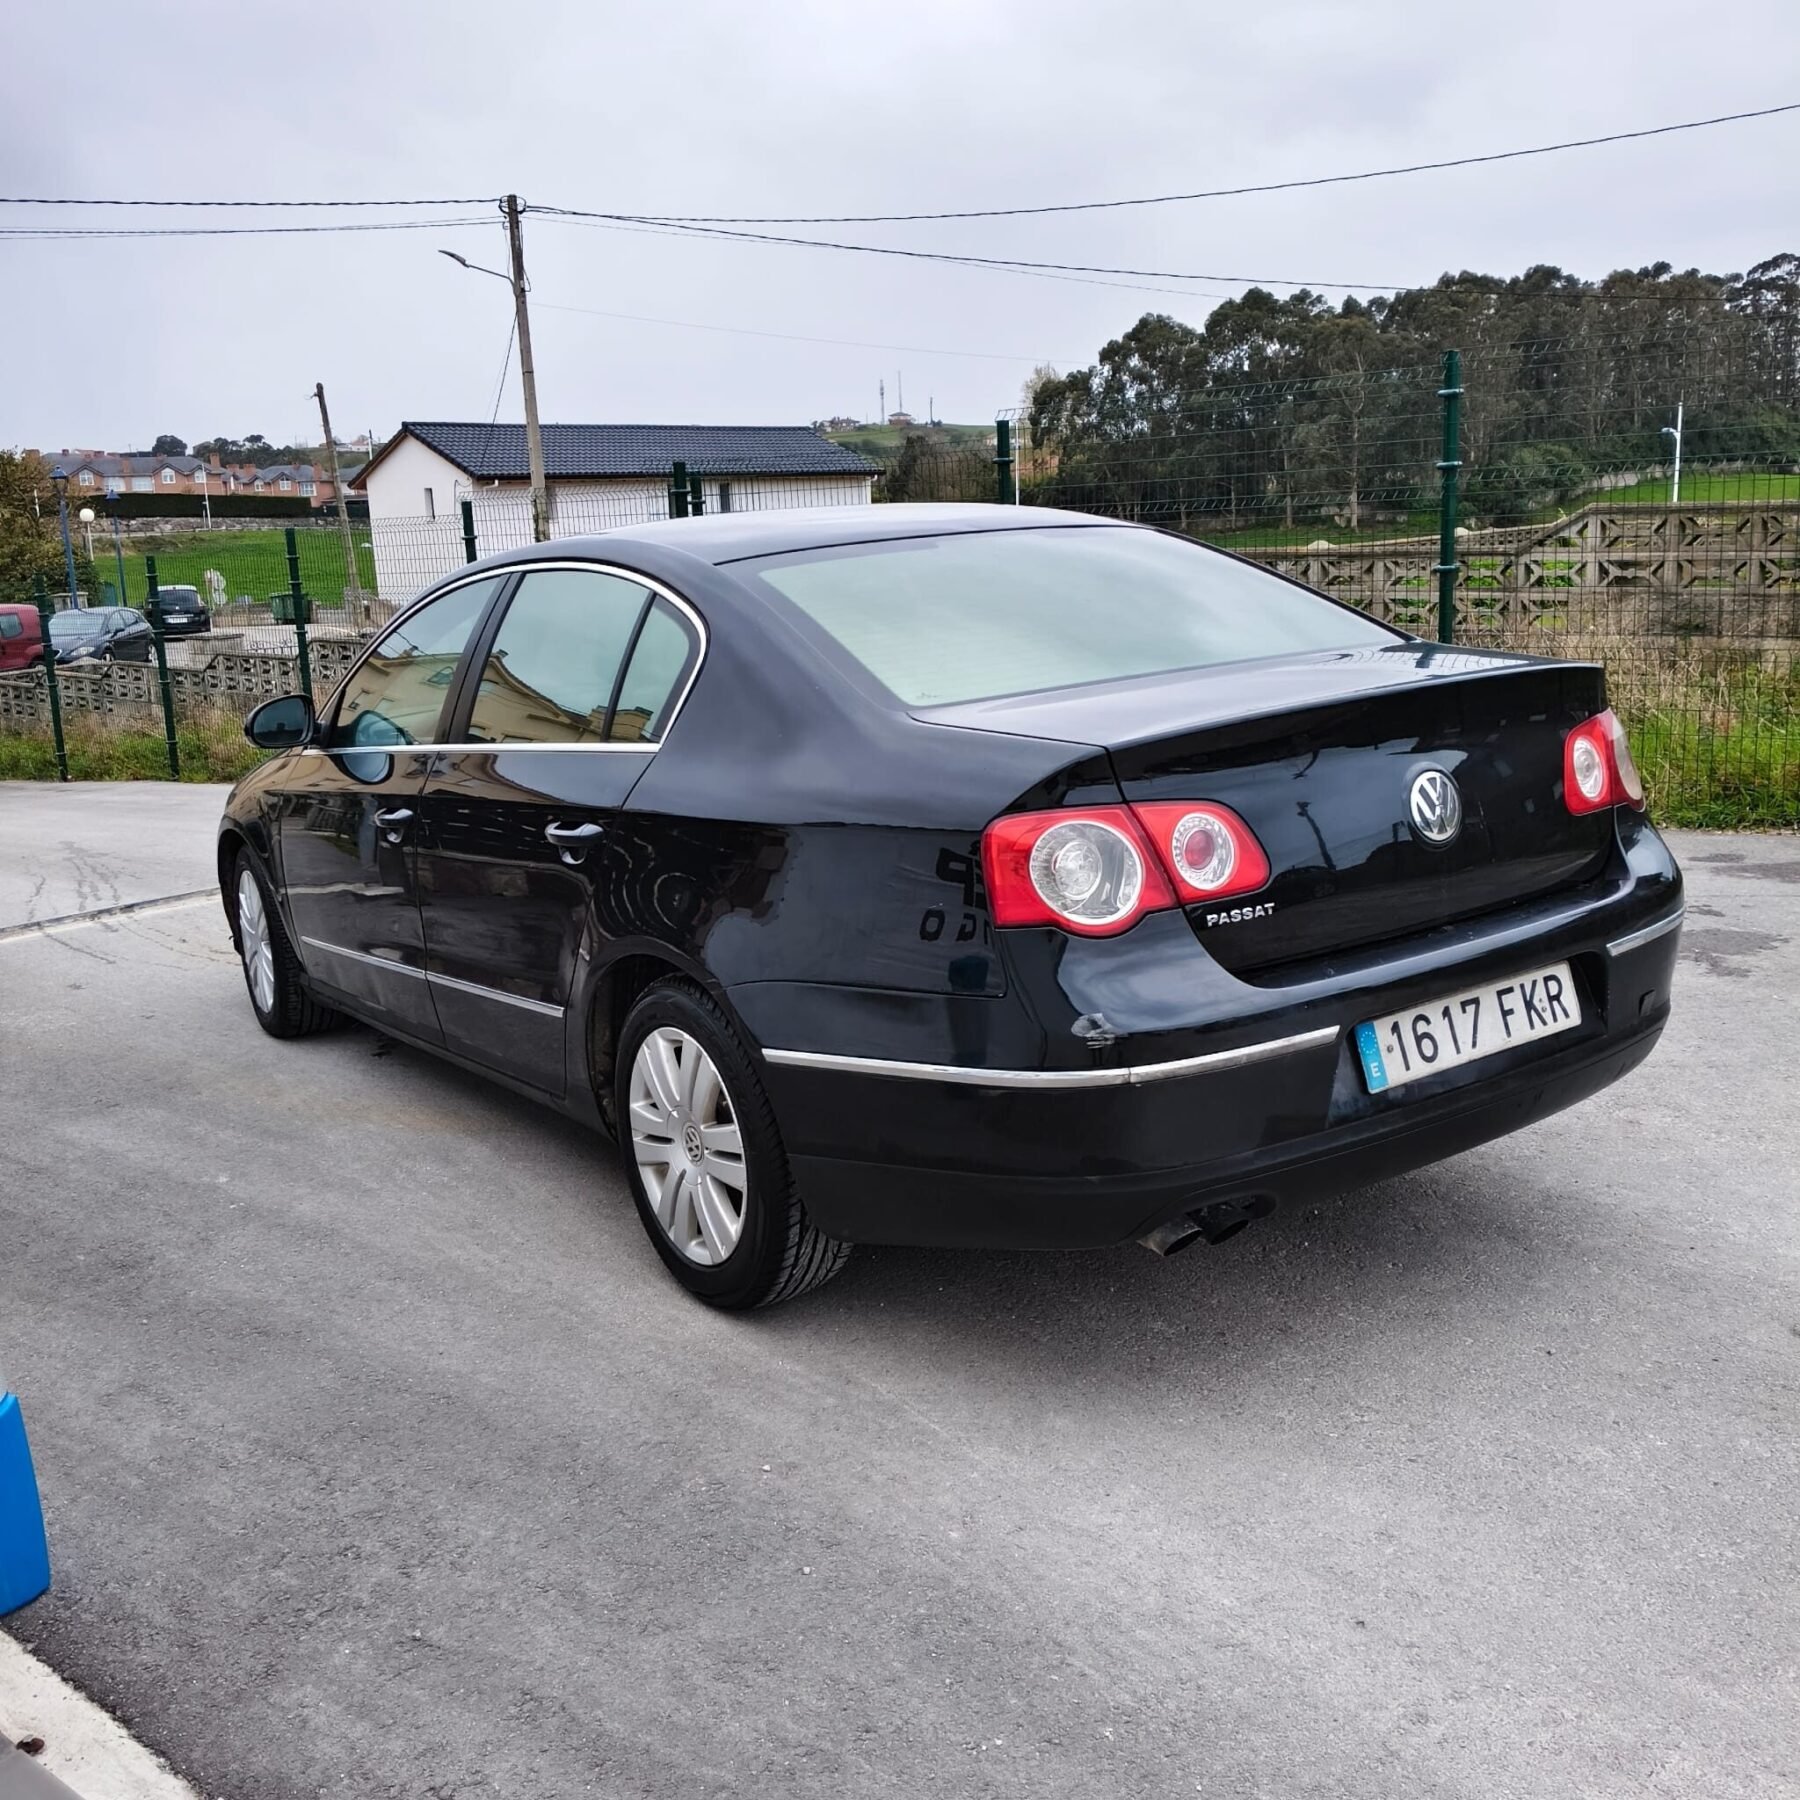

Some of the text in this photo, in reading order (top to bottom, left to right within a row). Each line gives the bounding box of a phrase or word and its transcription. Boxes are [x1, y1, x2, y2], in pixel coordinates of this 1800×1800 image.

[1410, 769, 1460, 841] VW
[1206, 902, 1275, 927] PASSAT
[1390, 973, 1571, 1072] 1617 FKR
[1369, 1061, 1382, 1078] E
